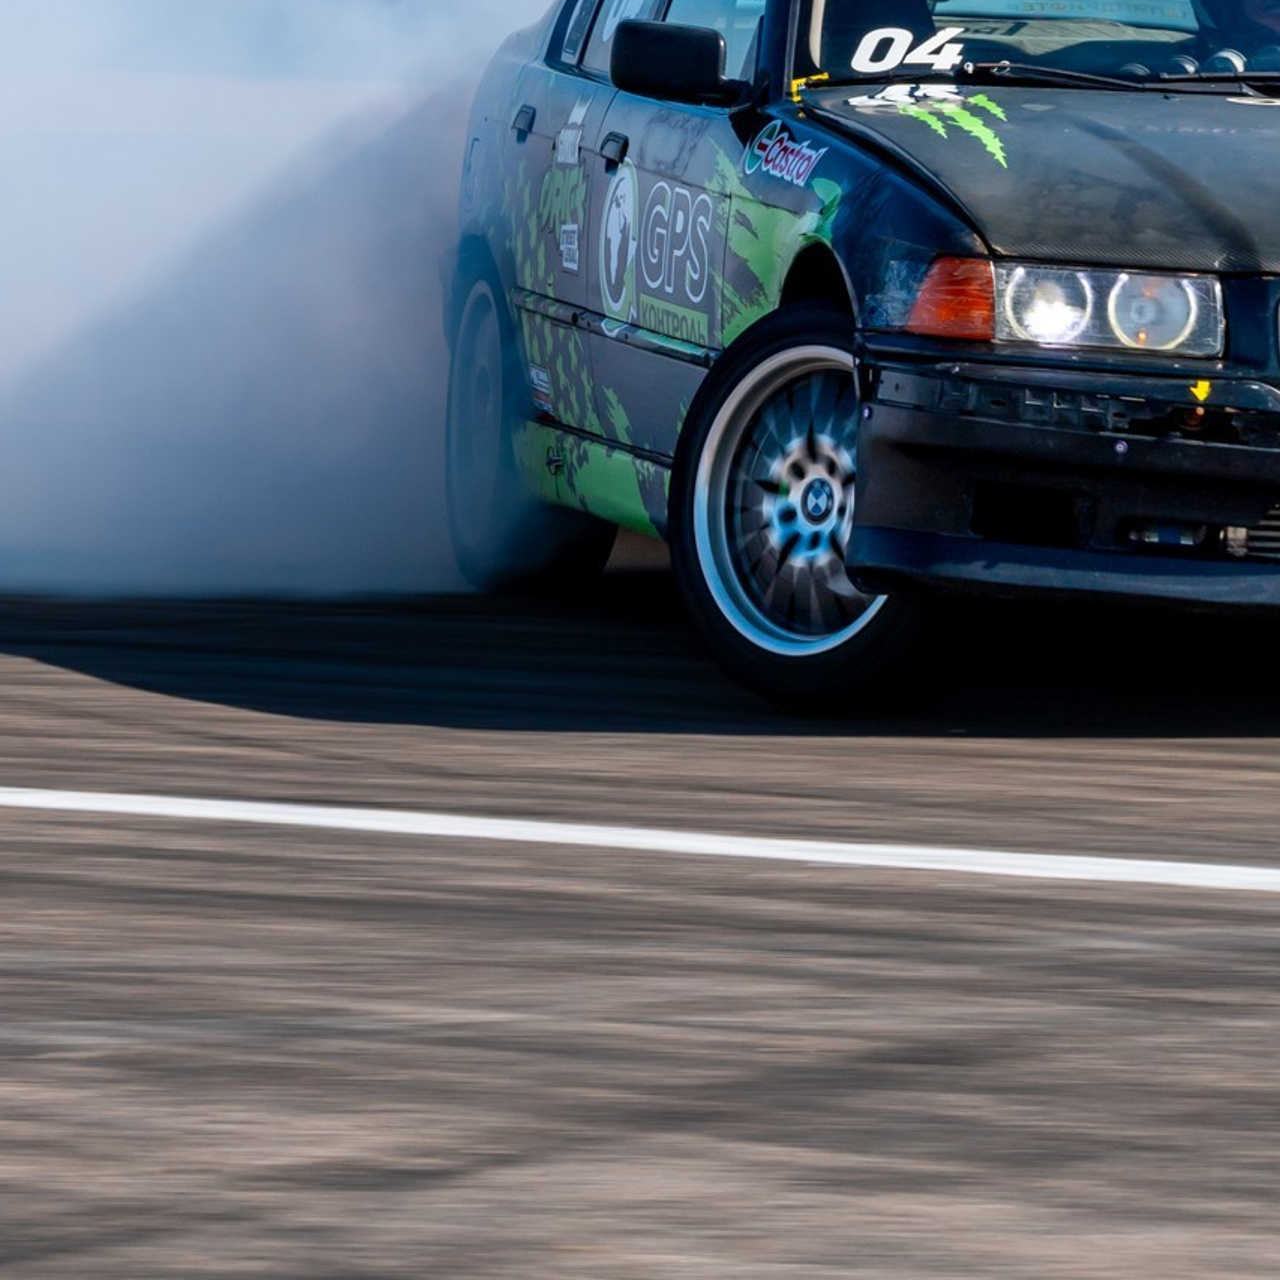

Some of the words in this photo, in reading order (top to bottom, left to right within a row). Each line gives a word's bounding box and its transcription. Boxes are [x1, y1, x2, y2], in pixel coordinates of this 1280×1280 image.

[851, 28, 966, 73] 04
[761, 132, 829, 187] Castrol
[641, 181, 712, 303] GPS
[642, 299, 707, 346] КОНТРОЛЬ
